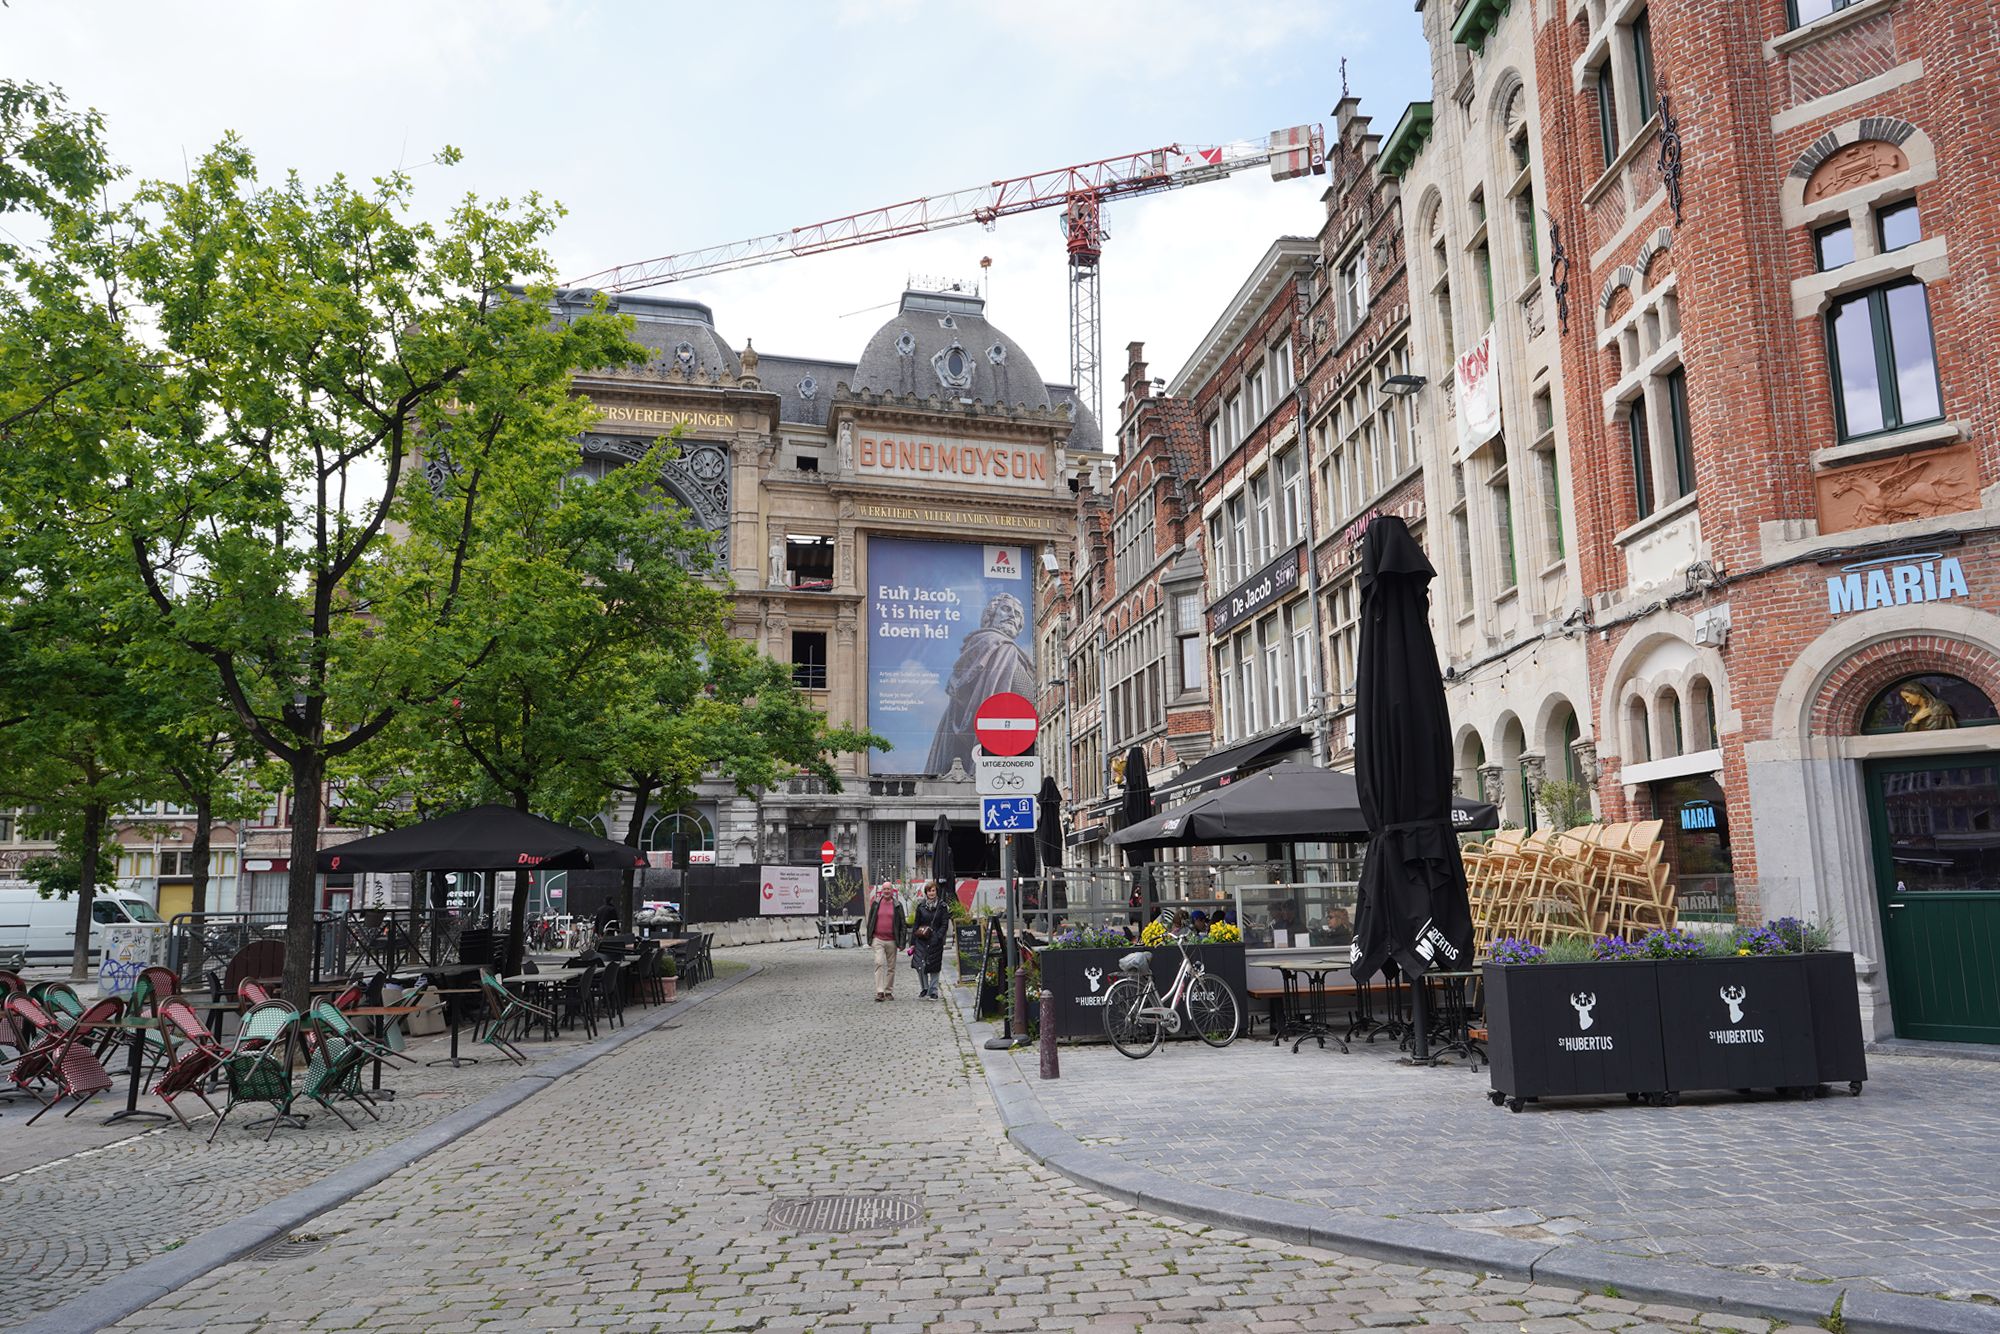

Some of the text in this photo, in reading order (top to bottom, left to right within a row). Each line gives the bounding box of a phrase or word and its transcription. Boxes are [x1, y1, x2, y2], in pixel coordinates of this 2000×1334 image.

[924, 510, 951, 521] ALLER
[990, 566, 1016, 574] ARTES
[879, 586, 961, 605] Euh Jacob,
[1232, 578, 1272, 617] De Jacob
[892, 604, 905, 619] is
[909, 605, 942, 620] hier
[945, 607, 961, 621] te
[879, 623, 949, 639] doen hé!
[982, 760, 1034, 768] UITGEZONDERD
[690, 853, 711, 862] aris
[1080, 996, 1113, 1006] HUBERTS
[1182, 992, 1216, 1001] HBERTUS
[1717, 1029, 1765, 1044] HUBERTUS
[1565, 1036, 1614, 1051] HUBERTUS
